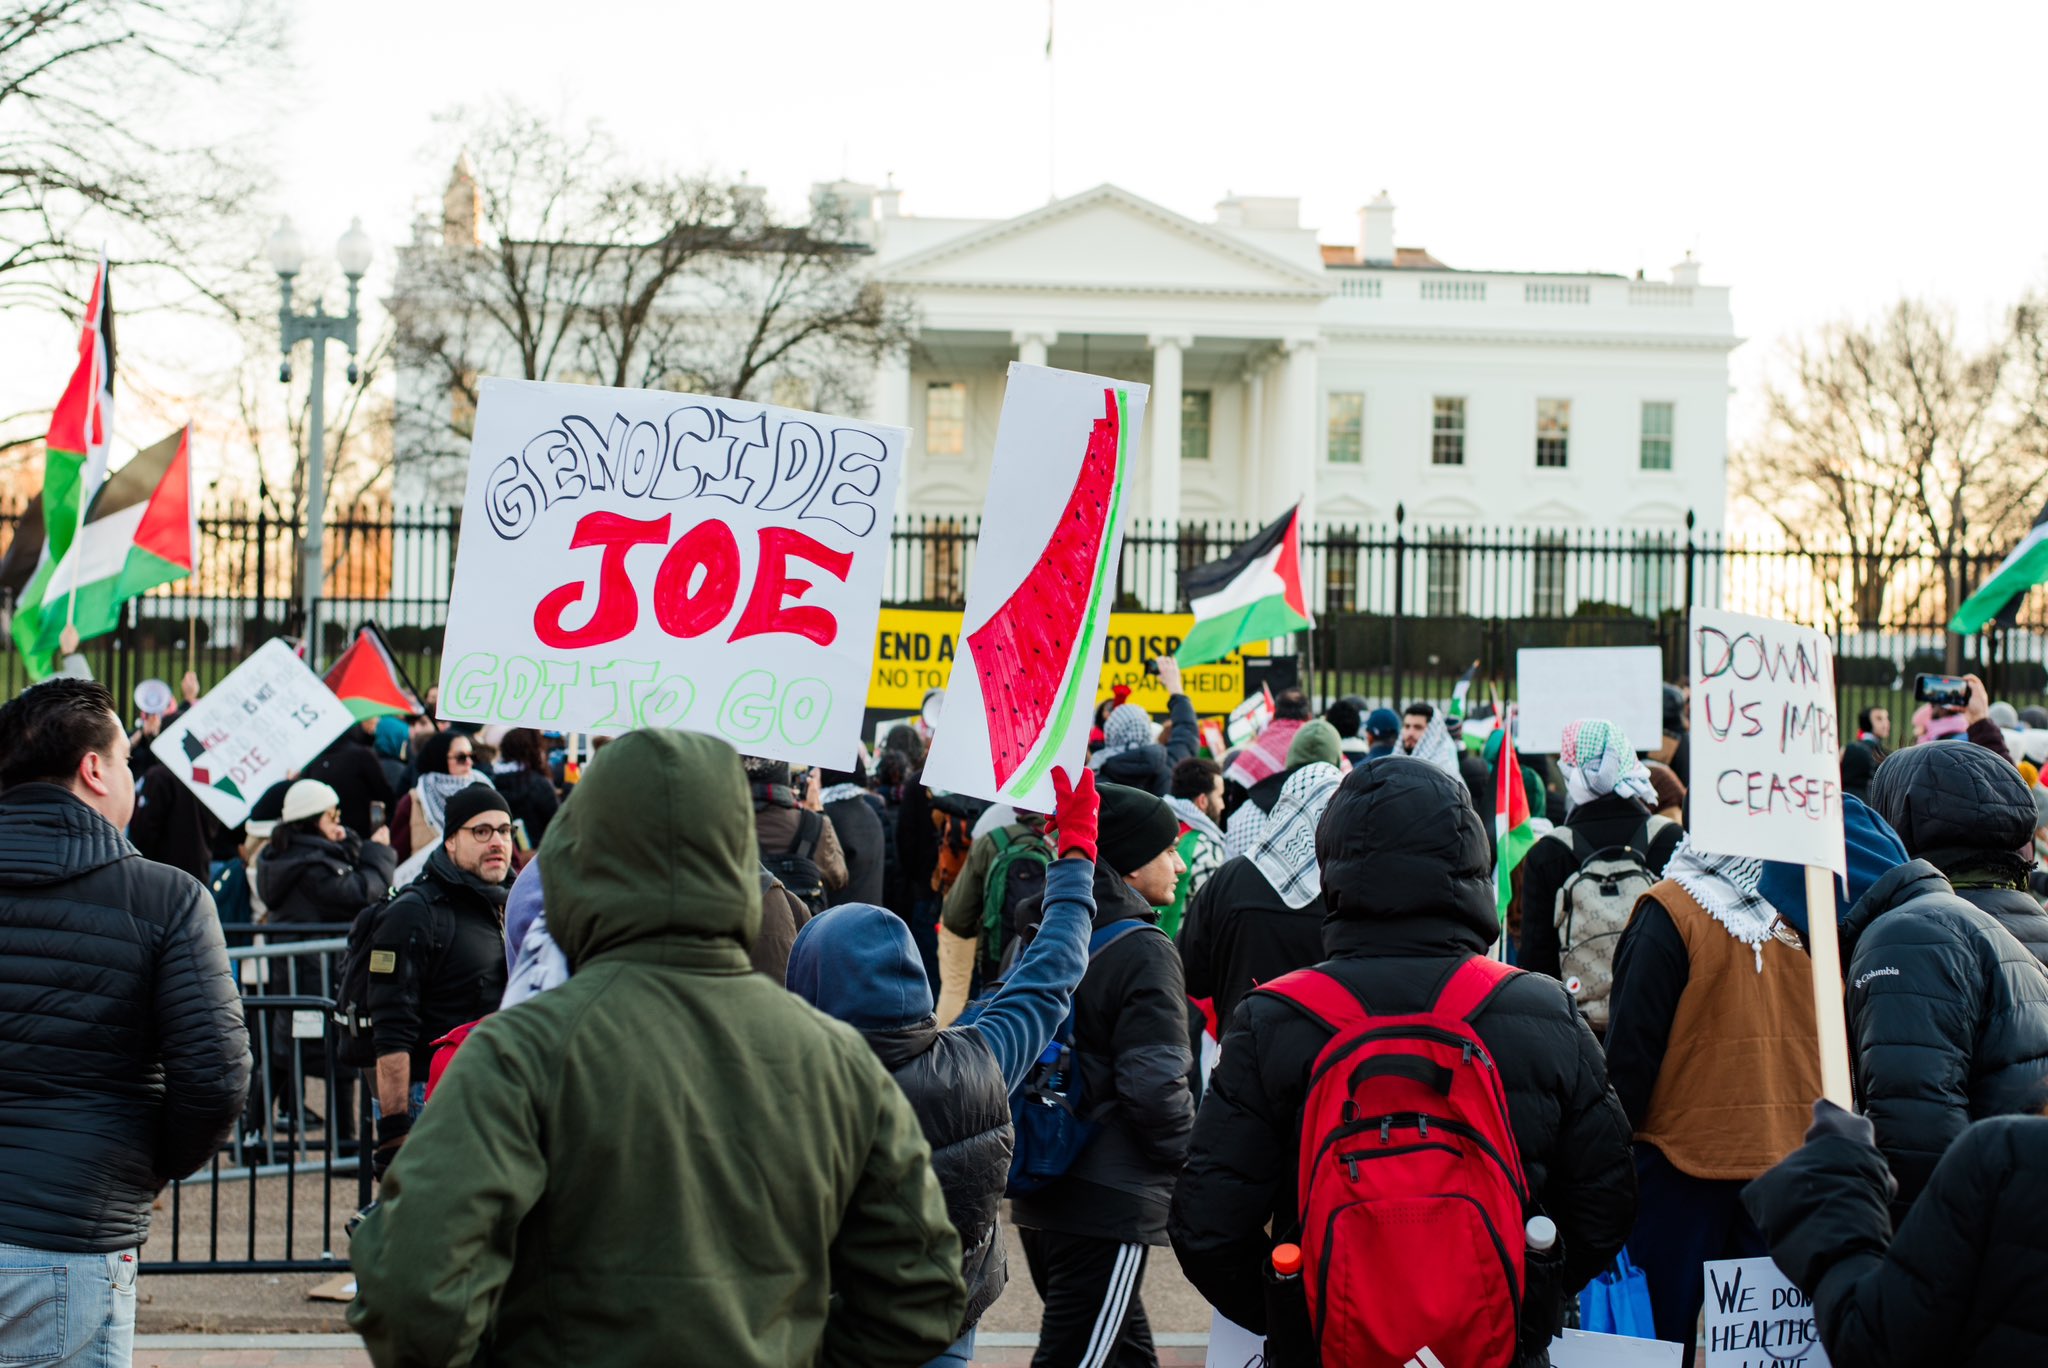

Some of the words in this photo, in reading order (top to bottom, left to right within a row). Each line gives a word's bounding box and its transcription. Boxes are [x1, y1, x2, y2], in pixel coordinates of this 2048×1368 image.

[485, 406, 888, 541] GENOCIDE
[533, 511, 854, 649] JOE
[880, 631, 932, 662] END
[1695, 625, 1820, 686] DOWN
[442, 652, 580, 721] GOT
[591, 659, 695, 730] TO
[716, 669, 833, 746] GO
[877, 669, 909, 689] NO
[912, 669, 943, 690] TO
[1110, 672, 1240, 693] APARHEID!
[1705, 689, 1763, 742] US
[229, 746, 271, 785] DIE
[1861, 966, 1900, 983] Columbia
[1710, 1267, 1758, 1314] WE
[1712, 1318, 1823, 1353] HEALTHC
